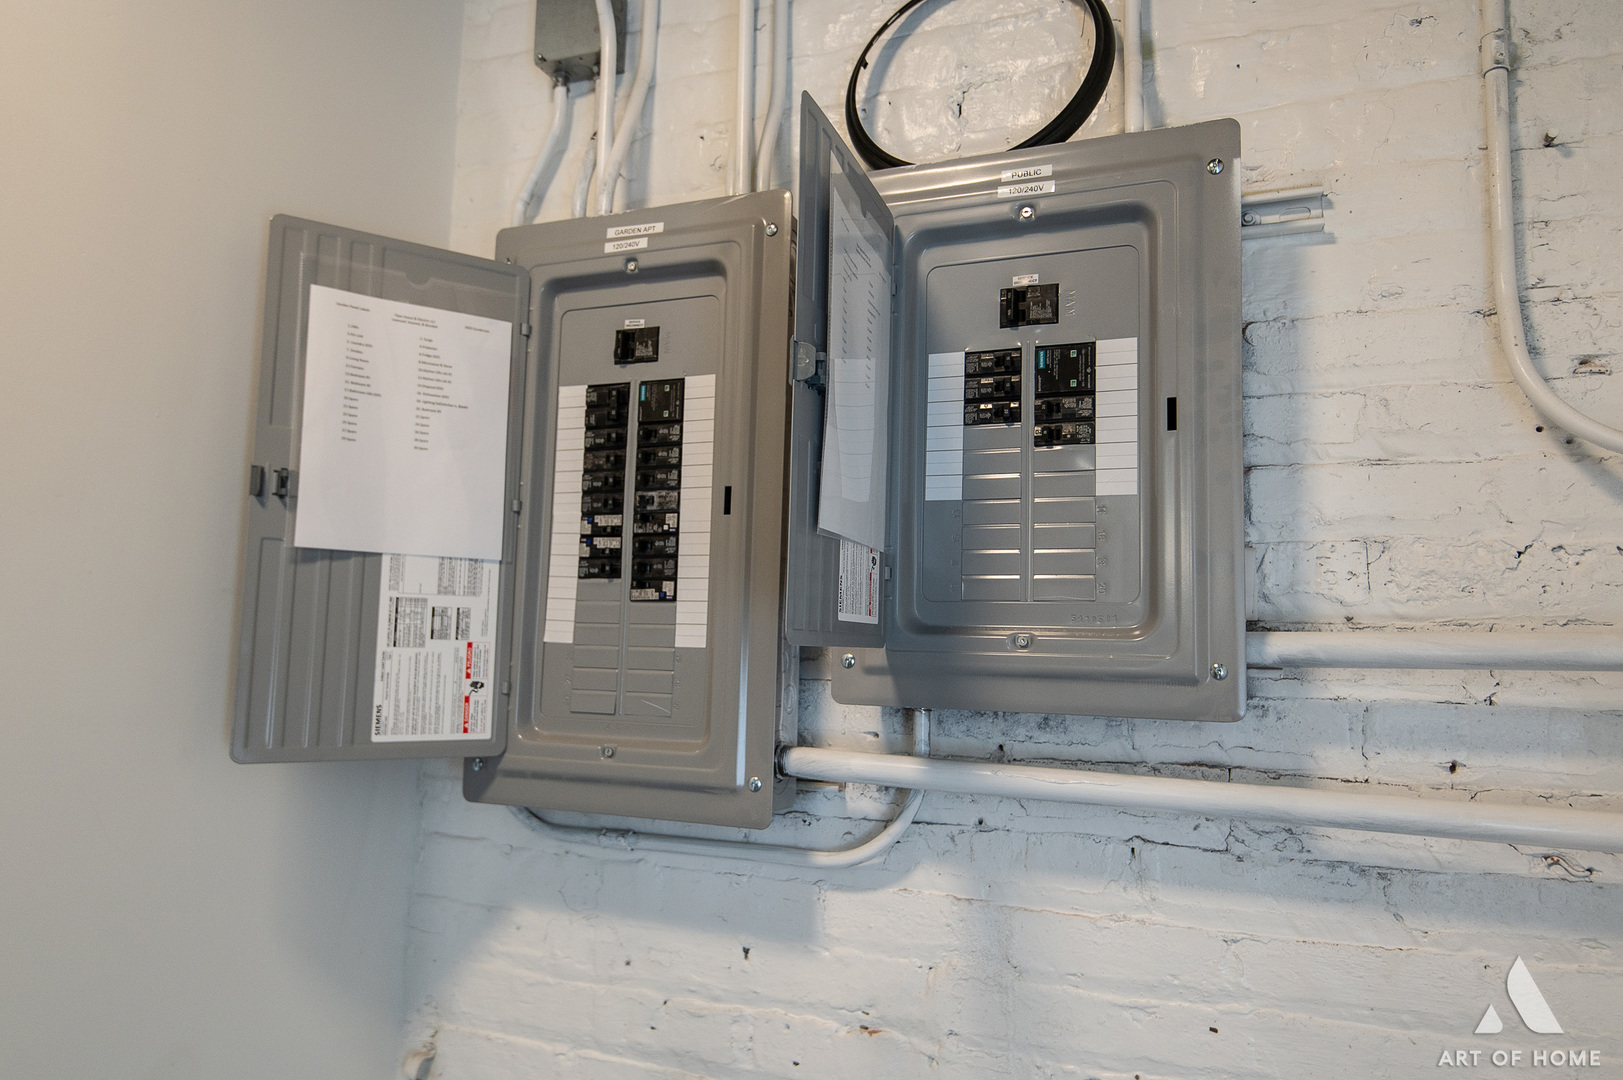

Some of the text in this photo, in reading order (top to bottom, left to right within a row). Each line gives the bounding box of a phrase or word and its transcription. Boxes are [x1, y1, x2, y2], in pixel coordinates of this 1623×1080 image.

[1011, 168, 1042, 179] PUBLIC
[1008, 184, 1045, 195] 120/240V
[614, 225, 656, 236] GARDEN APT
[612, 240, 641, 250] 120/240V
[374, 704, 382, 736] SIEMENS
